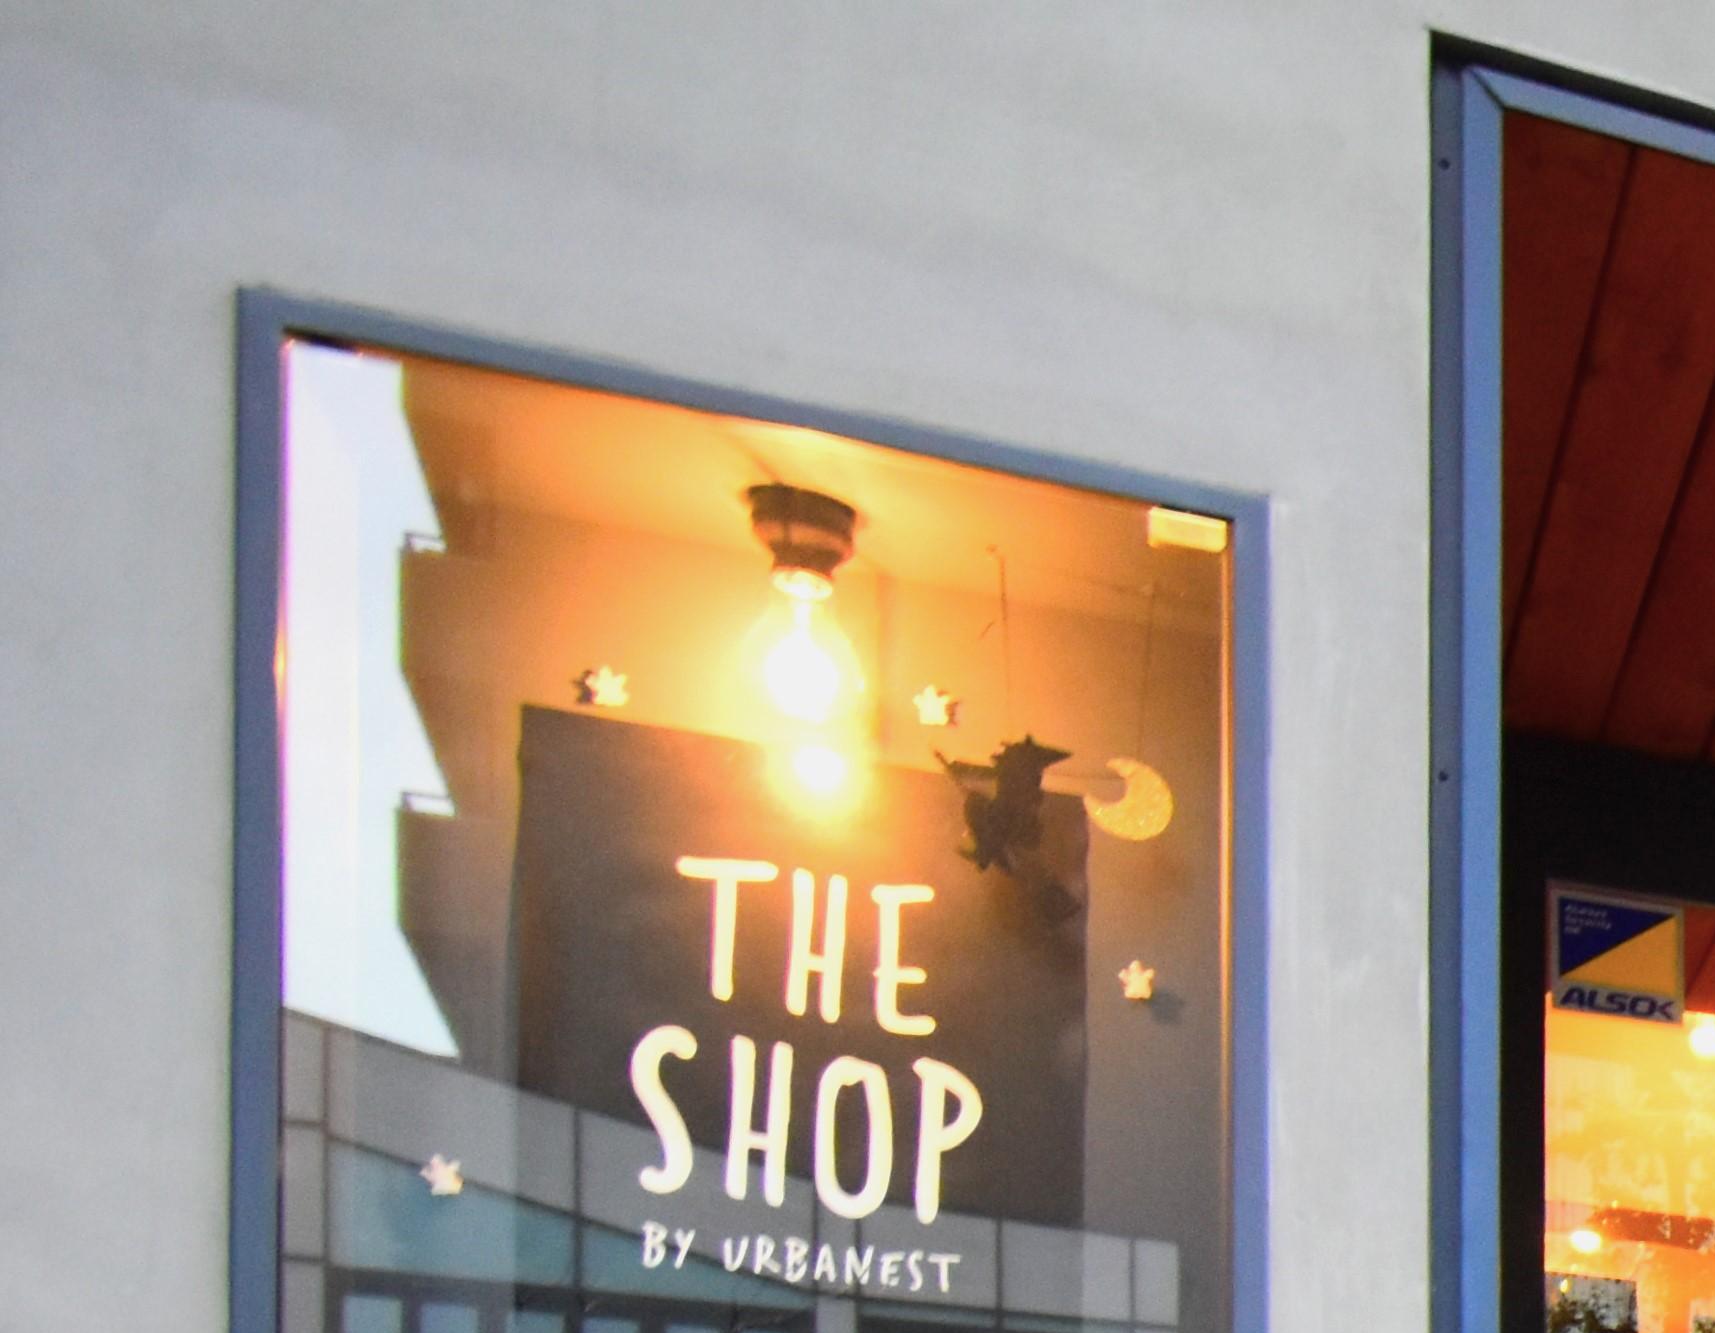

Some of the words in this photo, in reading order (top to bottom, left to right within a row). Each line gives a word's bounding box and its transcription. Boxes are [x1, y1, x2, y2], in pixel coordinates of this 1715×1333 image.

[677, 855, 936, 1036] THE
[1559, 986, 1676, 1021] ALSOK
[629, 1024, 984, 1224] SHOP
[641, 1222, 699, 1270] BY
[722, 1236, 963, 1293] URBANEST
